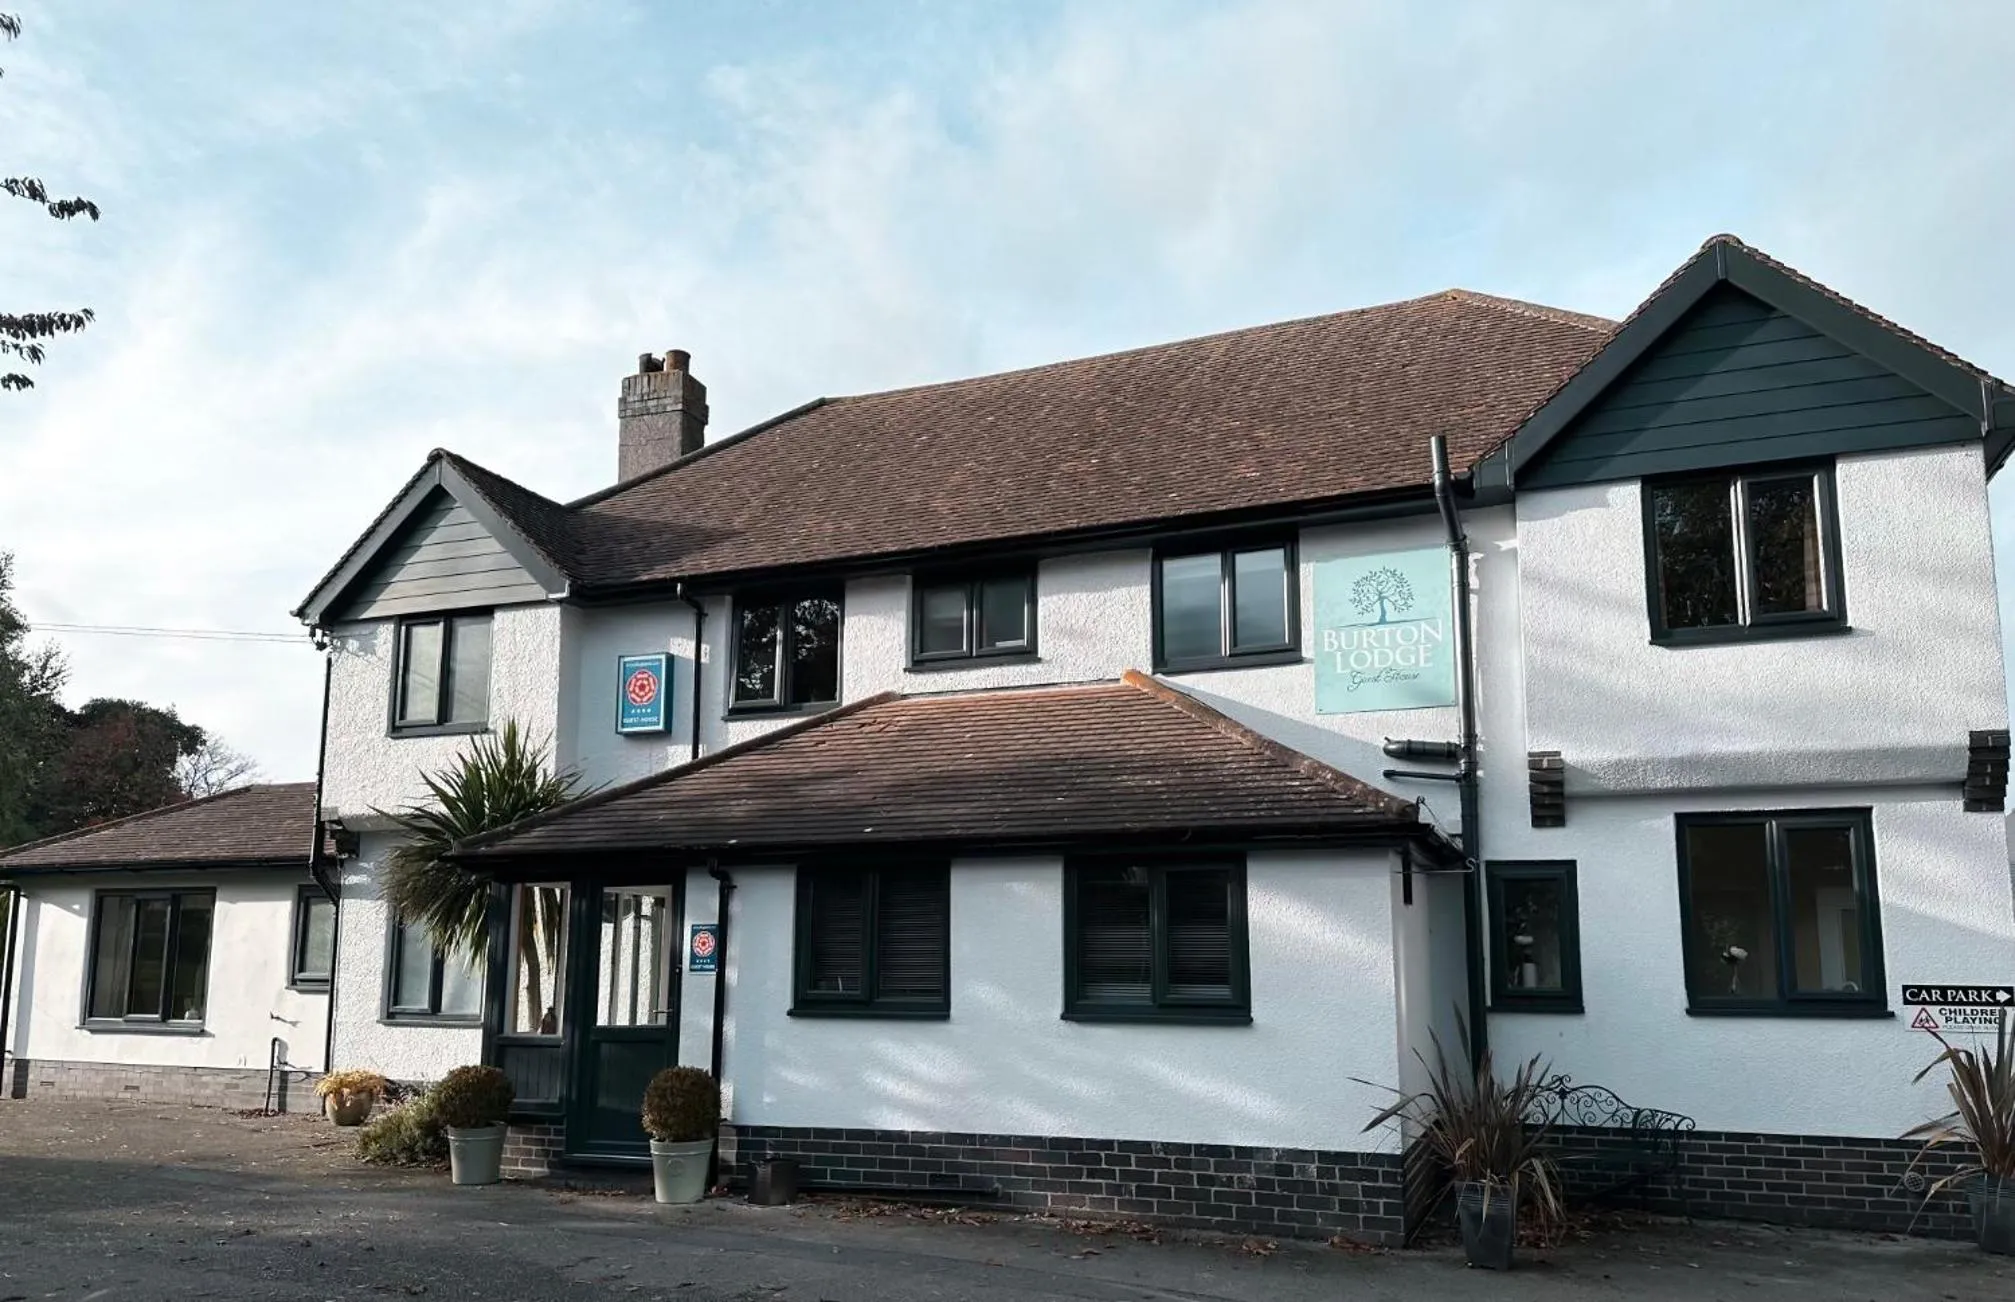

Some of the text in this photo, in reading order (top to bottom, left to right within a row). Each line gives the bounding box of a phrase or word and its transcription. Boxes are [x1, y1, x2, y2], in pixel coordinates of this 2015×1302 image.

[1322, 619, 1442, 652] BURTON
[1336, 645, 1433, 673] LODGE
[1906, 989, 1994, 1002] CAR PARK
[1939, 1008, 2000, 1016] CHILDRE
